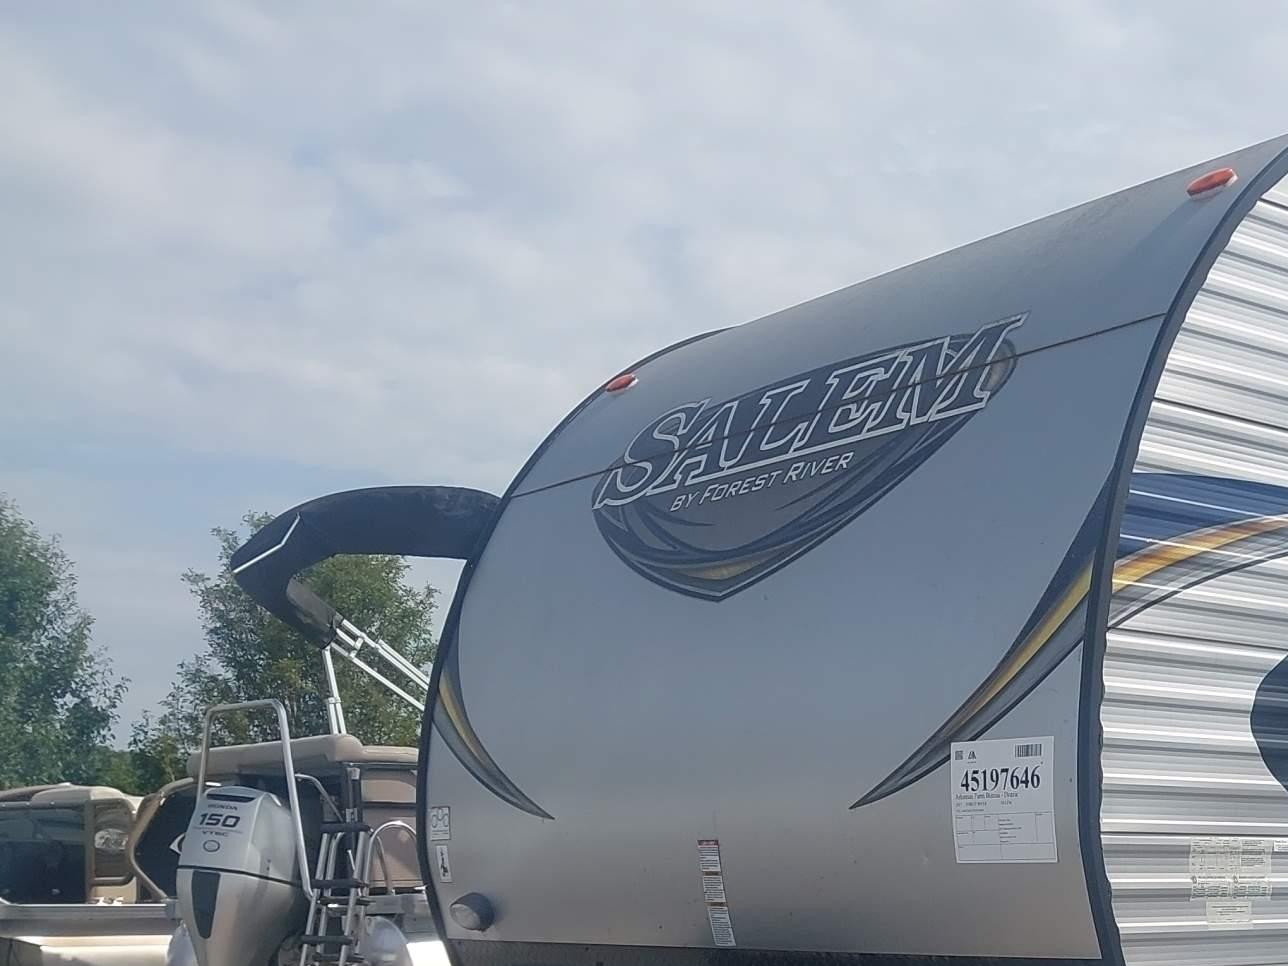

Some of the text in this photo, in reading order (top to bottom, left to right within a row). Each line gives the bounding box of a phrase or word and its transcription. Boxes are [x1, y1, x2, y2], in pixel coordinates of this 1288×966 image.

[592, 310, 1031, 510] SALEM
[670, 452, 855, 512] BY FOREST RIVER
[960, 765, 1041, 792] 45197646
[199, 812, 241, 828] 150
